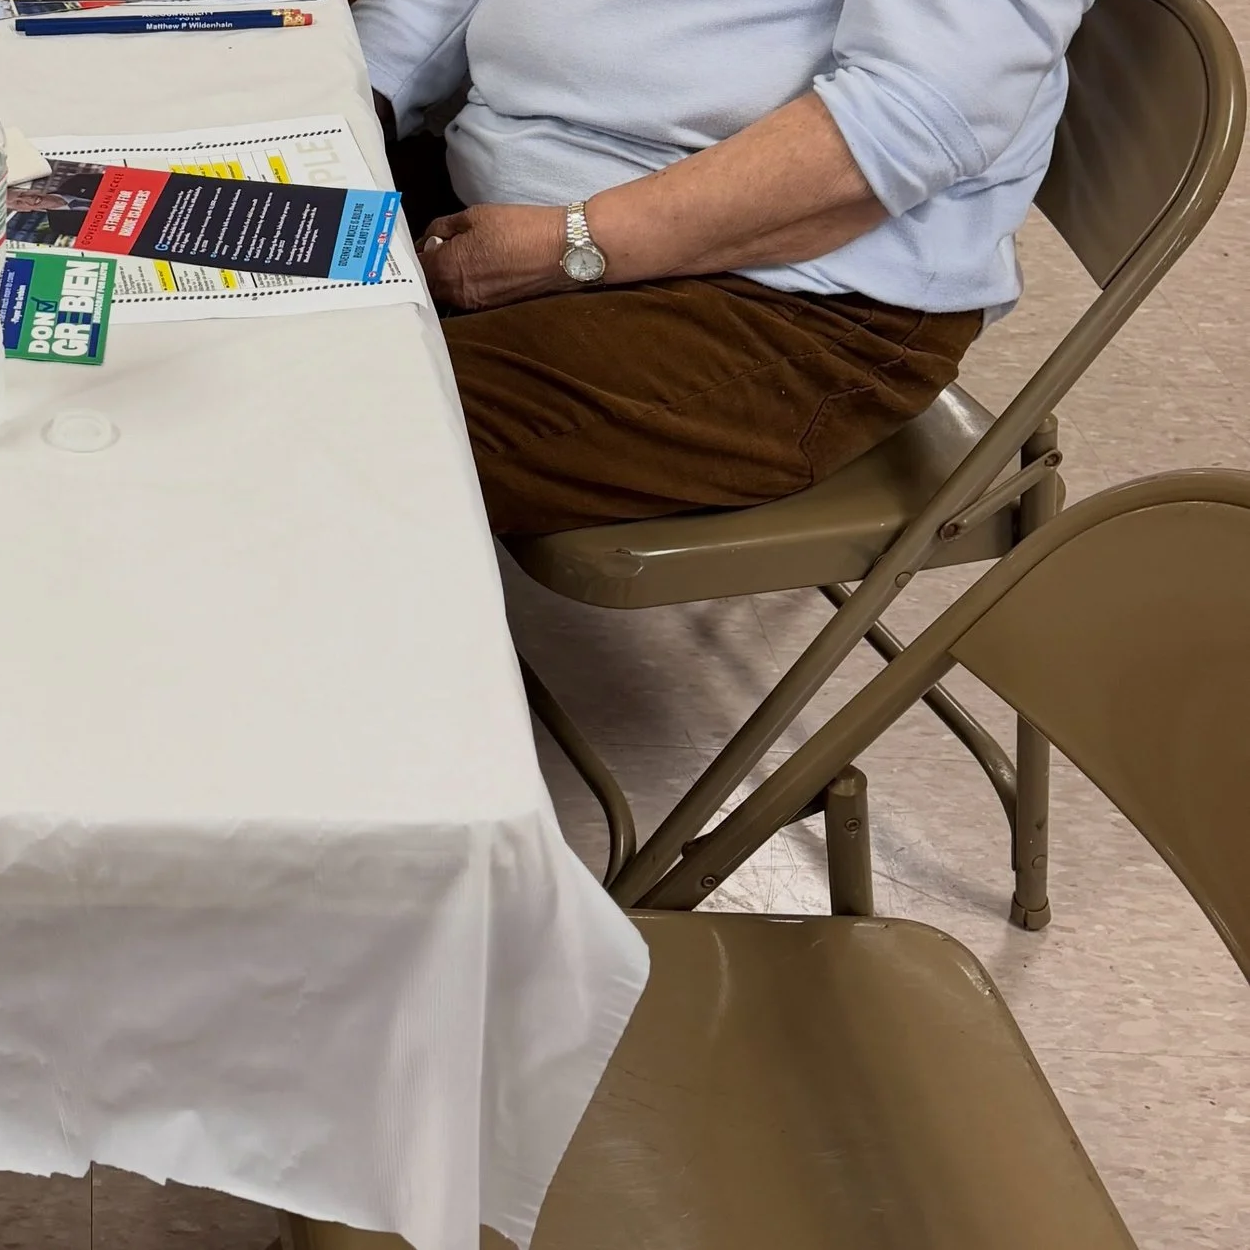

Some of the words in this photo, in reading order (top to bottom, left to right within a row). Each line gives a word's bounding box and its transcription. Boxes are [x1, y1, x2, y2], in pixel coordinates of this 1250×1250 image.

[295, 139, 348, 185] PLE
[115, 190, 134, 201] FOR
[125, 189, 151, 218] ISLANDERS
[104, 201, 128, 225] FIGHTING
[116, 218, 138, 236] RHODE
[98, 261, 108, 280] MAYOR
[15, 284, 26, 300] Grebien
[96, 281, 106, 292] FOR
[50, 259, 100, 357] GREBIEN
[92, 293, 104, 323] DEMOCRAT
[28, 311, 56, 354] DON
